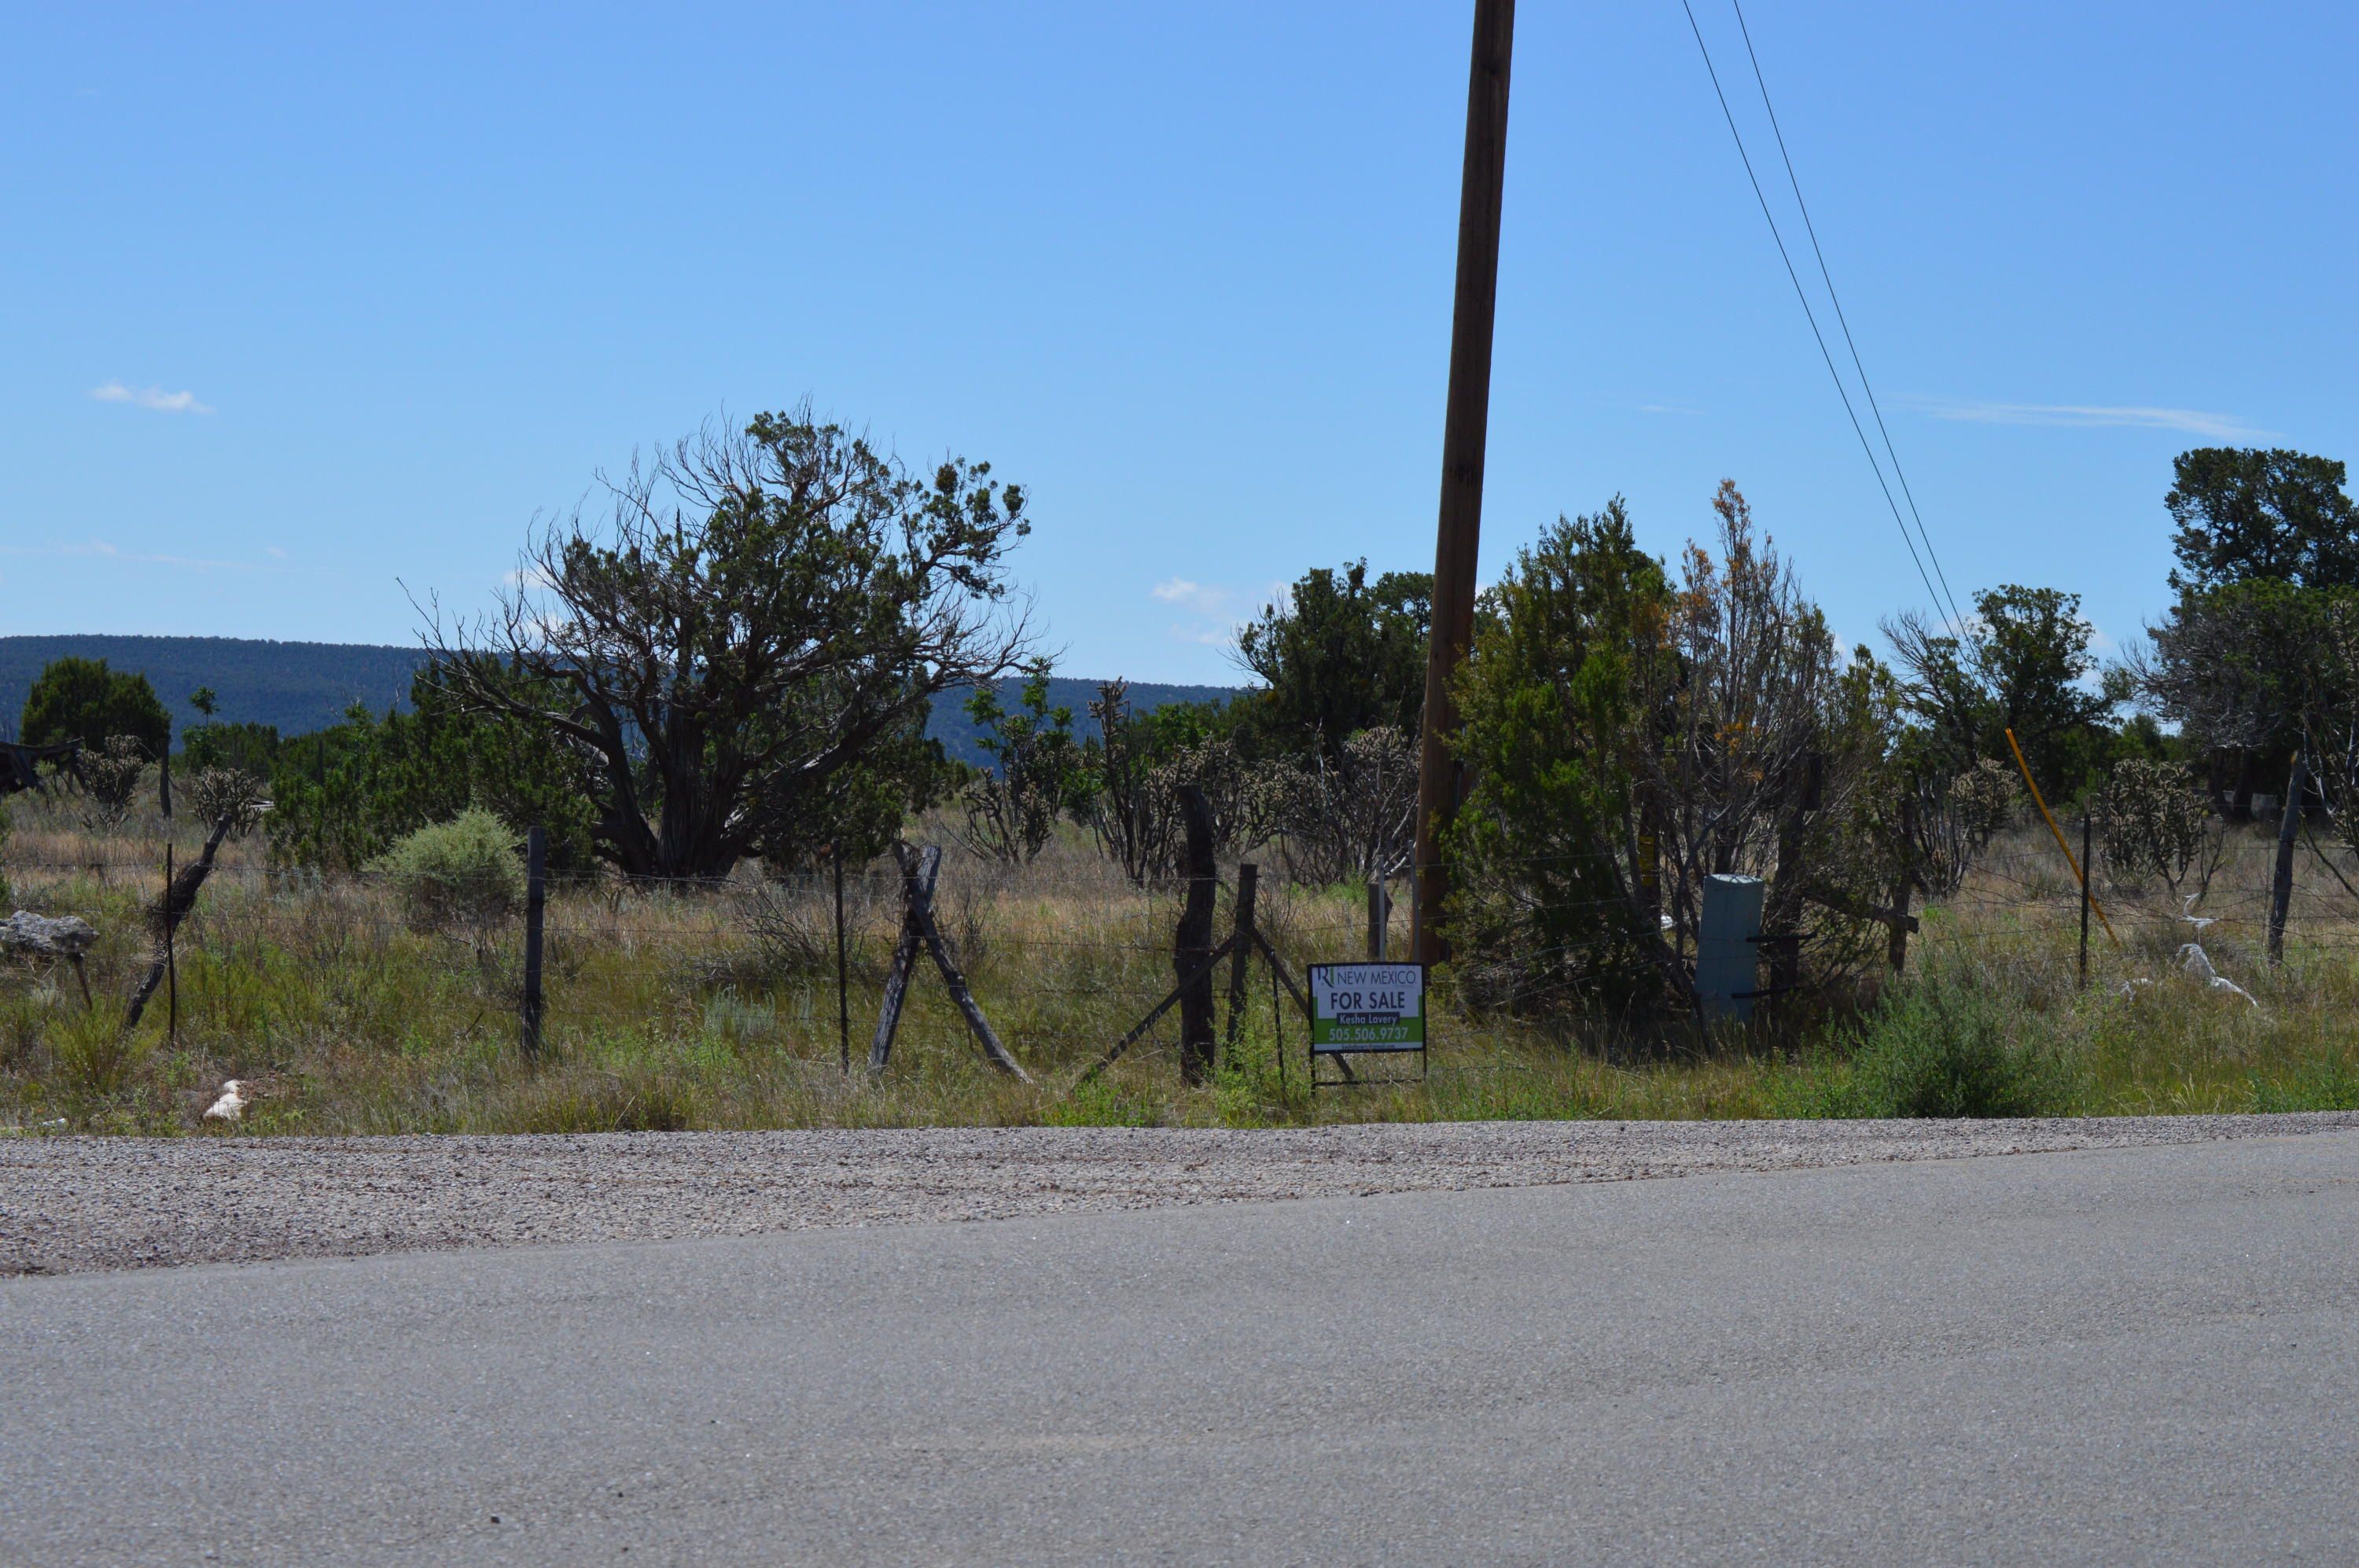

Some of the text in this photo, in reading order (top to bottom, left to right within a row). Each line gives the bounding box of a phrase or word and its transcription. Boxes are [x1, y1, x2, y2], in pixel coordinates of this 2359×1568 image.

[1338, 970, 1416, 985] NEW MEXICO
[1330, 992, 1404, 1010] FOR SALE
[1340, 1014, 1397, 1026] Kesha Lavery
[1329, 1027, 1408, 1041] 505.506.9737
